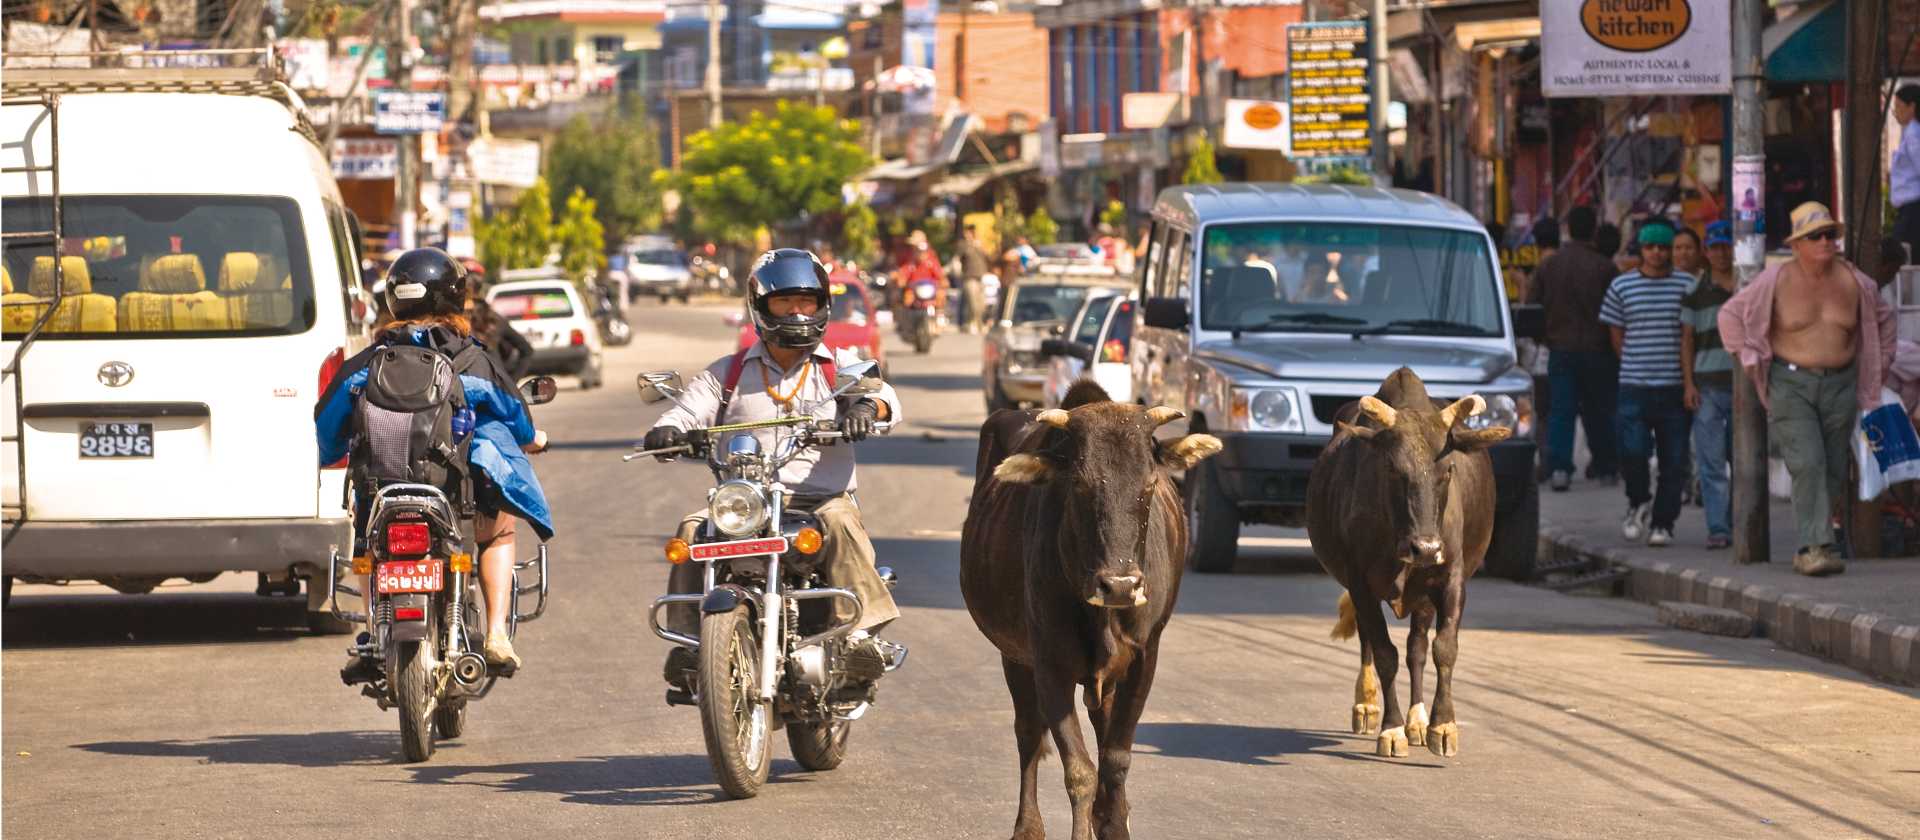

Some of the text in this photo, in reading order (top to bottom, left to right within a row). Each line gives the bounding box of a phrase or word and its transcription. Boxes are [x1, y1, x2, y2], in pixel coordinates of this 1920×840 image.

[1598, 15, 1674, 36] kitchen
[1583, 59, 1690, 70] AUTHENTIC LOCAL &
[1554, 73, 1721, 86] HOME-STYLE WESTERN CUISINE
[81, 436, 151, 456] २४५६
